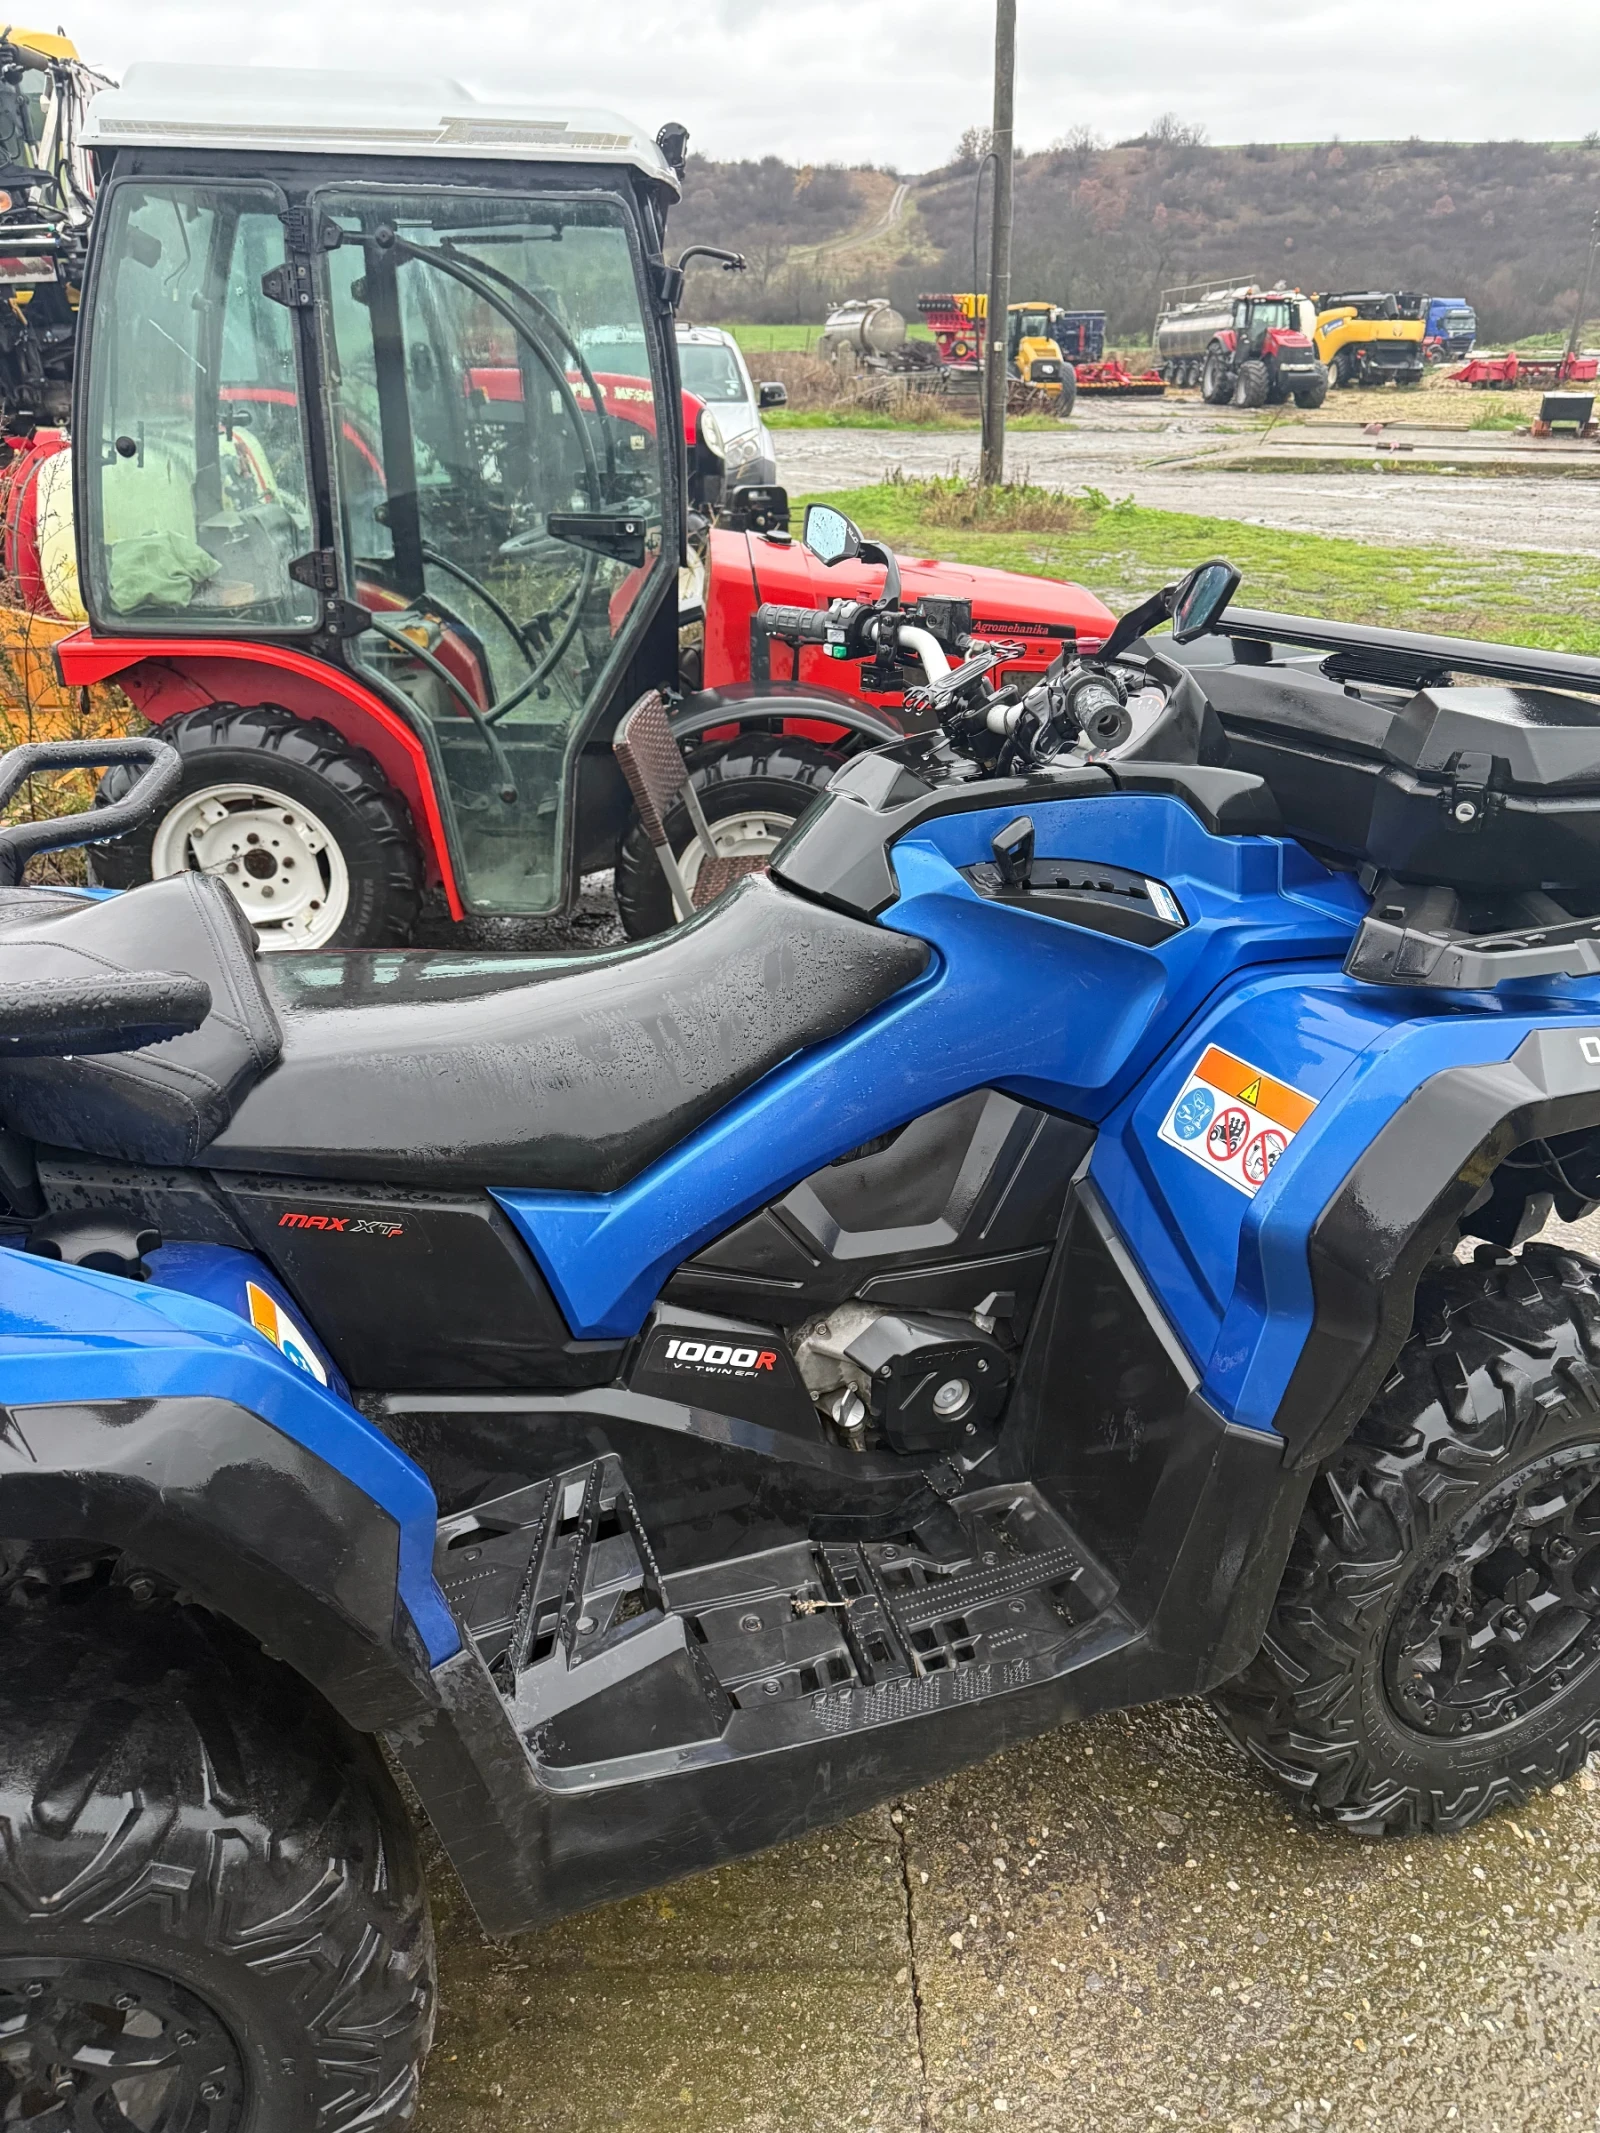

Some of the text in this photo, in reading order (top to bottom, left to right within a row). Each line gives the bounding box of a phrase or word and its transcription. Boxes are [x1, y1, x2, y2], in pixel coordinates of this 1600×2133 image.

[973, 620, 1049, 635] Agromehanika
[278, 1212, 351, 1232] MAX
[664, 1339, 777, 1371] 1000R
[734, 1369, 759, 1378] EFI
